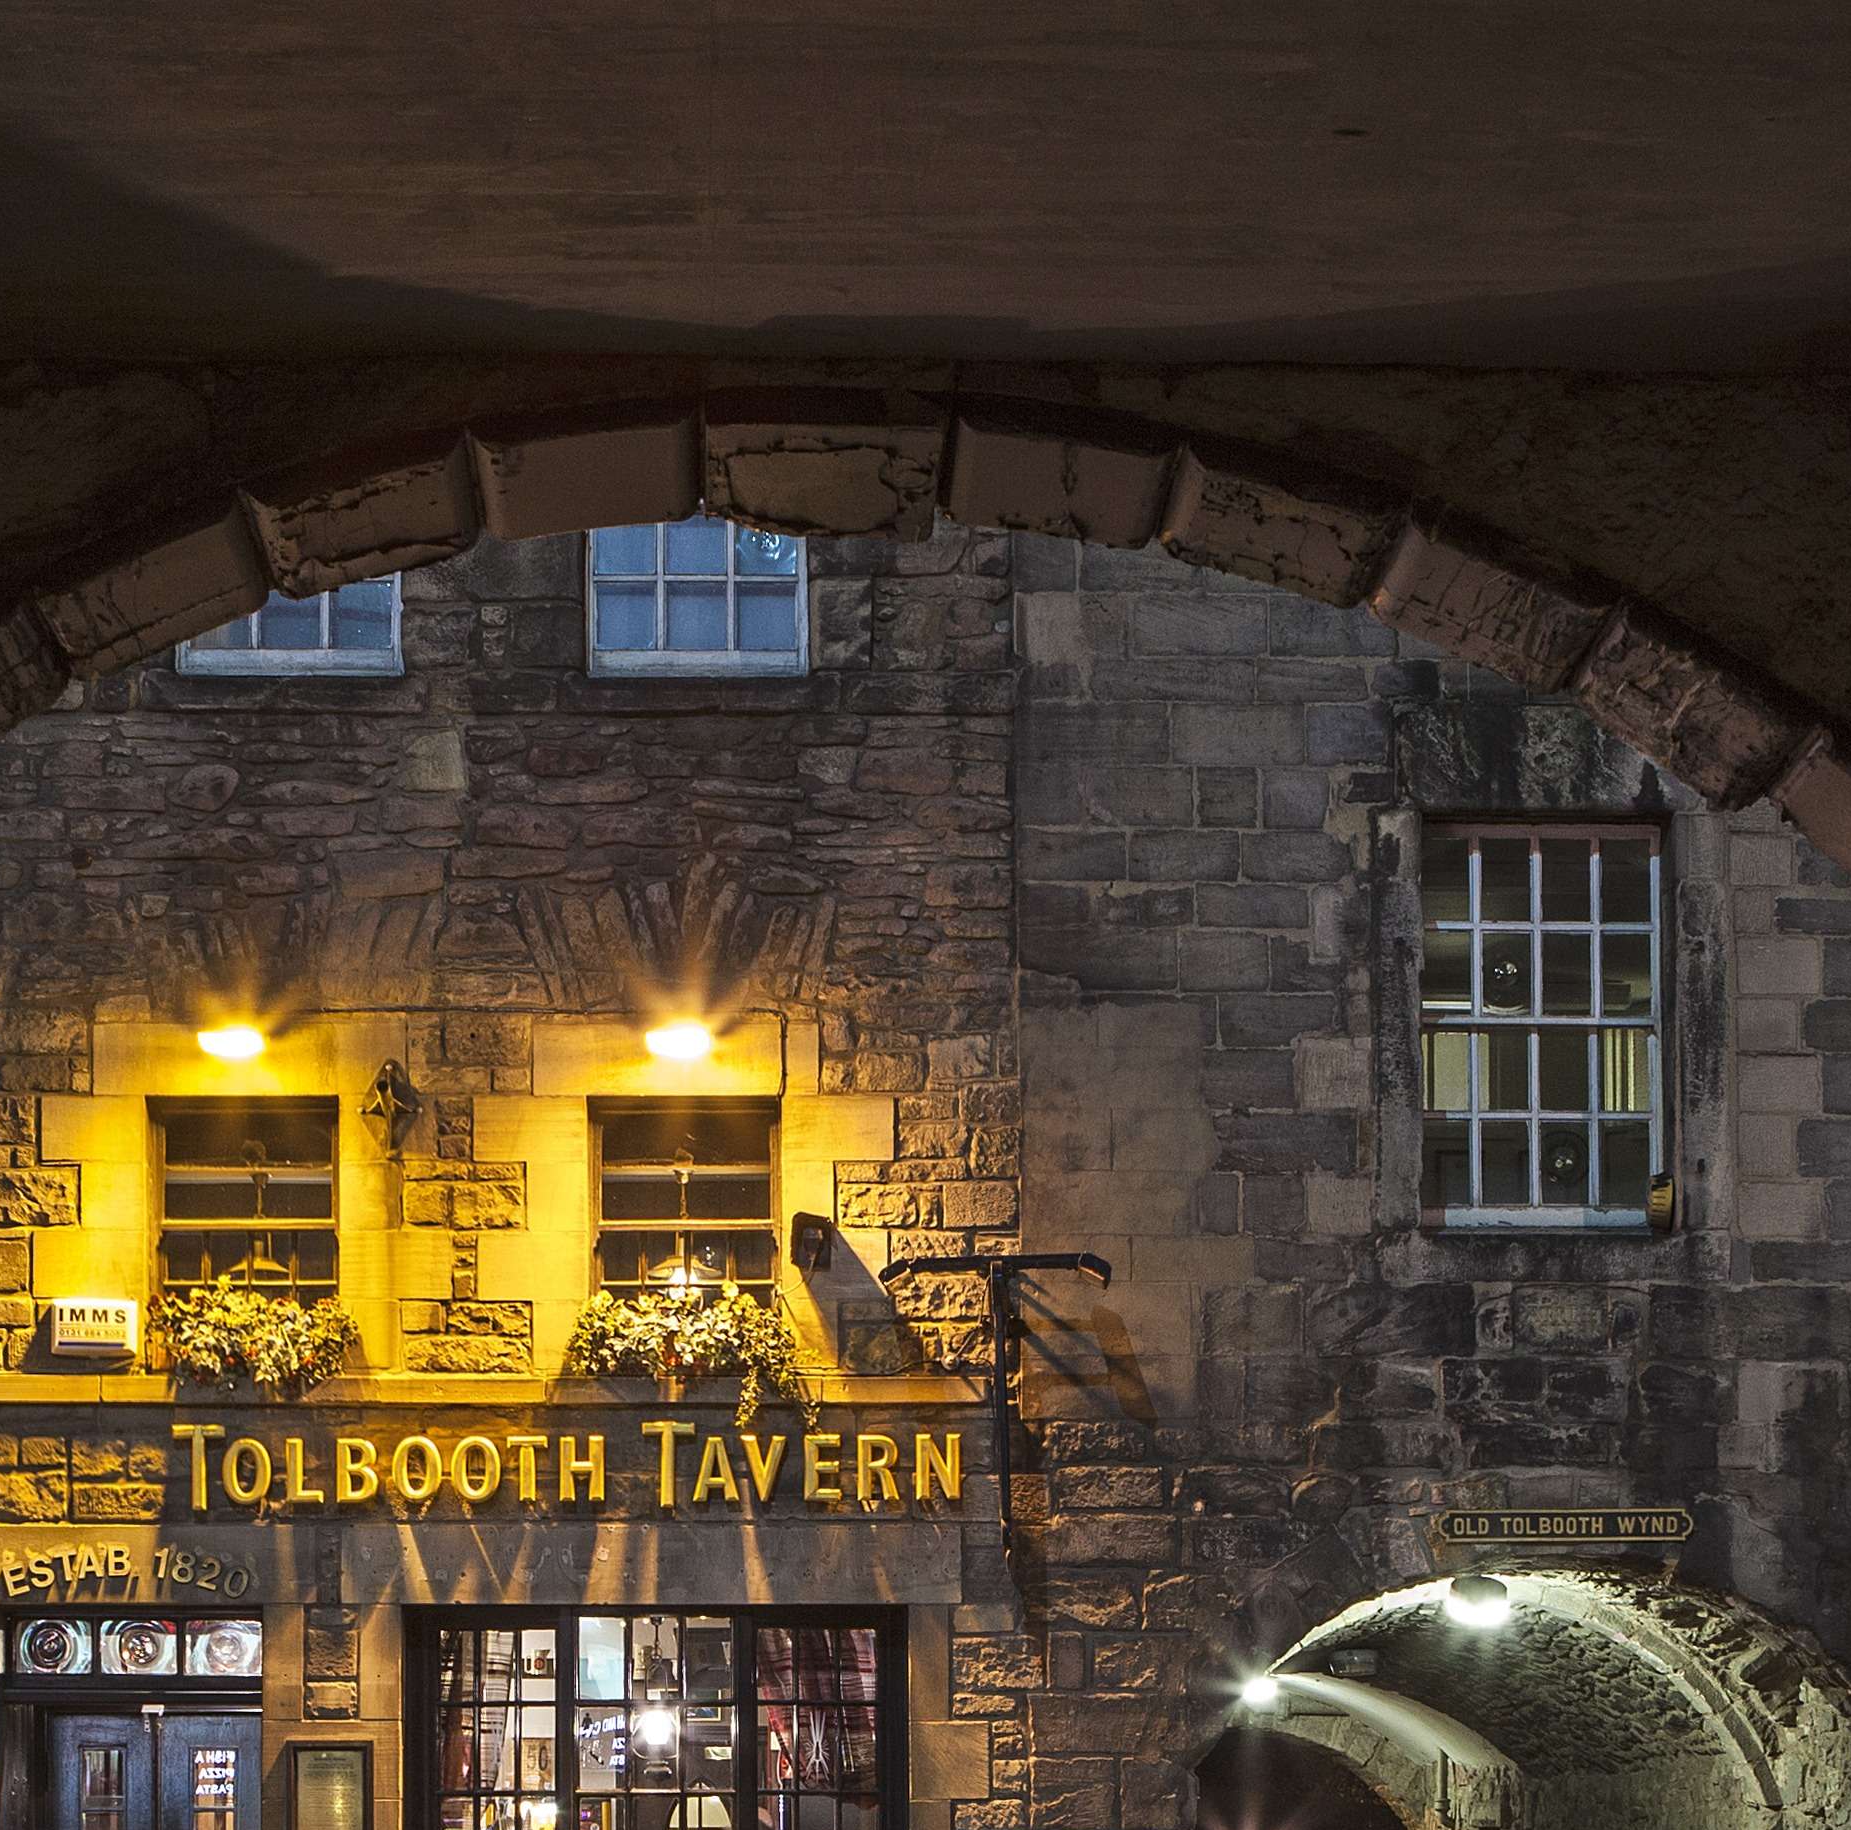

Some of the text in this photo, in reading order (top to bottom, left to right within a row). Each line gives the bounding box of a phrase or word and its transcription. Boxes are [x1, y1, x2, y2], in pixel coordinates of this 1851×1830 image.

[59, 1308, 126, 1323] IMMS
[171, 1420, 962, 1511] TOLBOOTH TAVERN
[1453, 1515, 1679, 1536] OLD TOLBOOTH WYND
[154, 1547, 249, 1598] 1820
